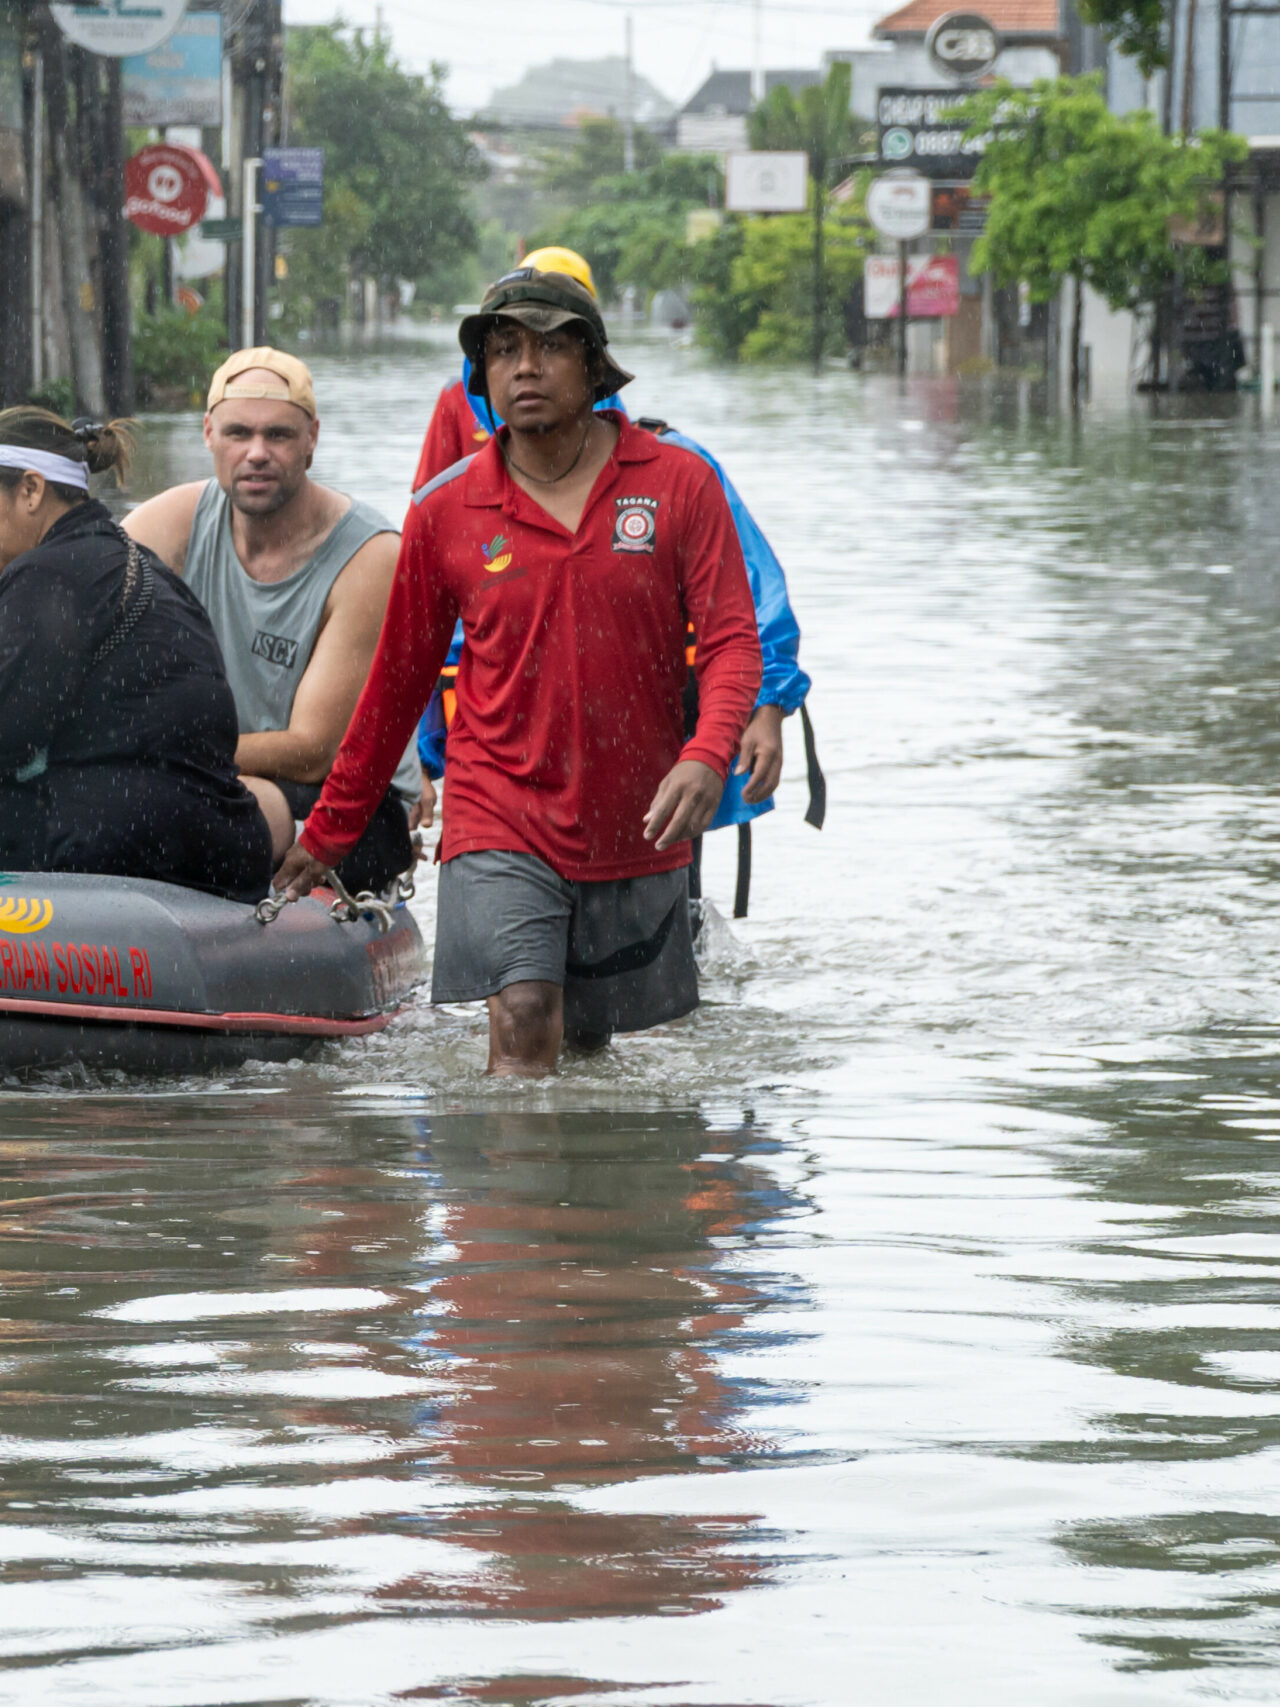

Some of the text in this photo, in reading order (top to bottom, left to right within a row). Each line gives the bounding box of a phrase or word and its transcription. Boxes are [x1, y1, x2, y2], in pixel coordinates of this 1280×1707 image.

[615, 496, 658, 509] TAGANA
[52, 941, 129, 998] SOSIAL
[128, 946, 153, 999] RI
